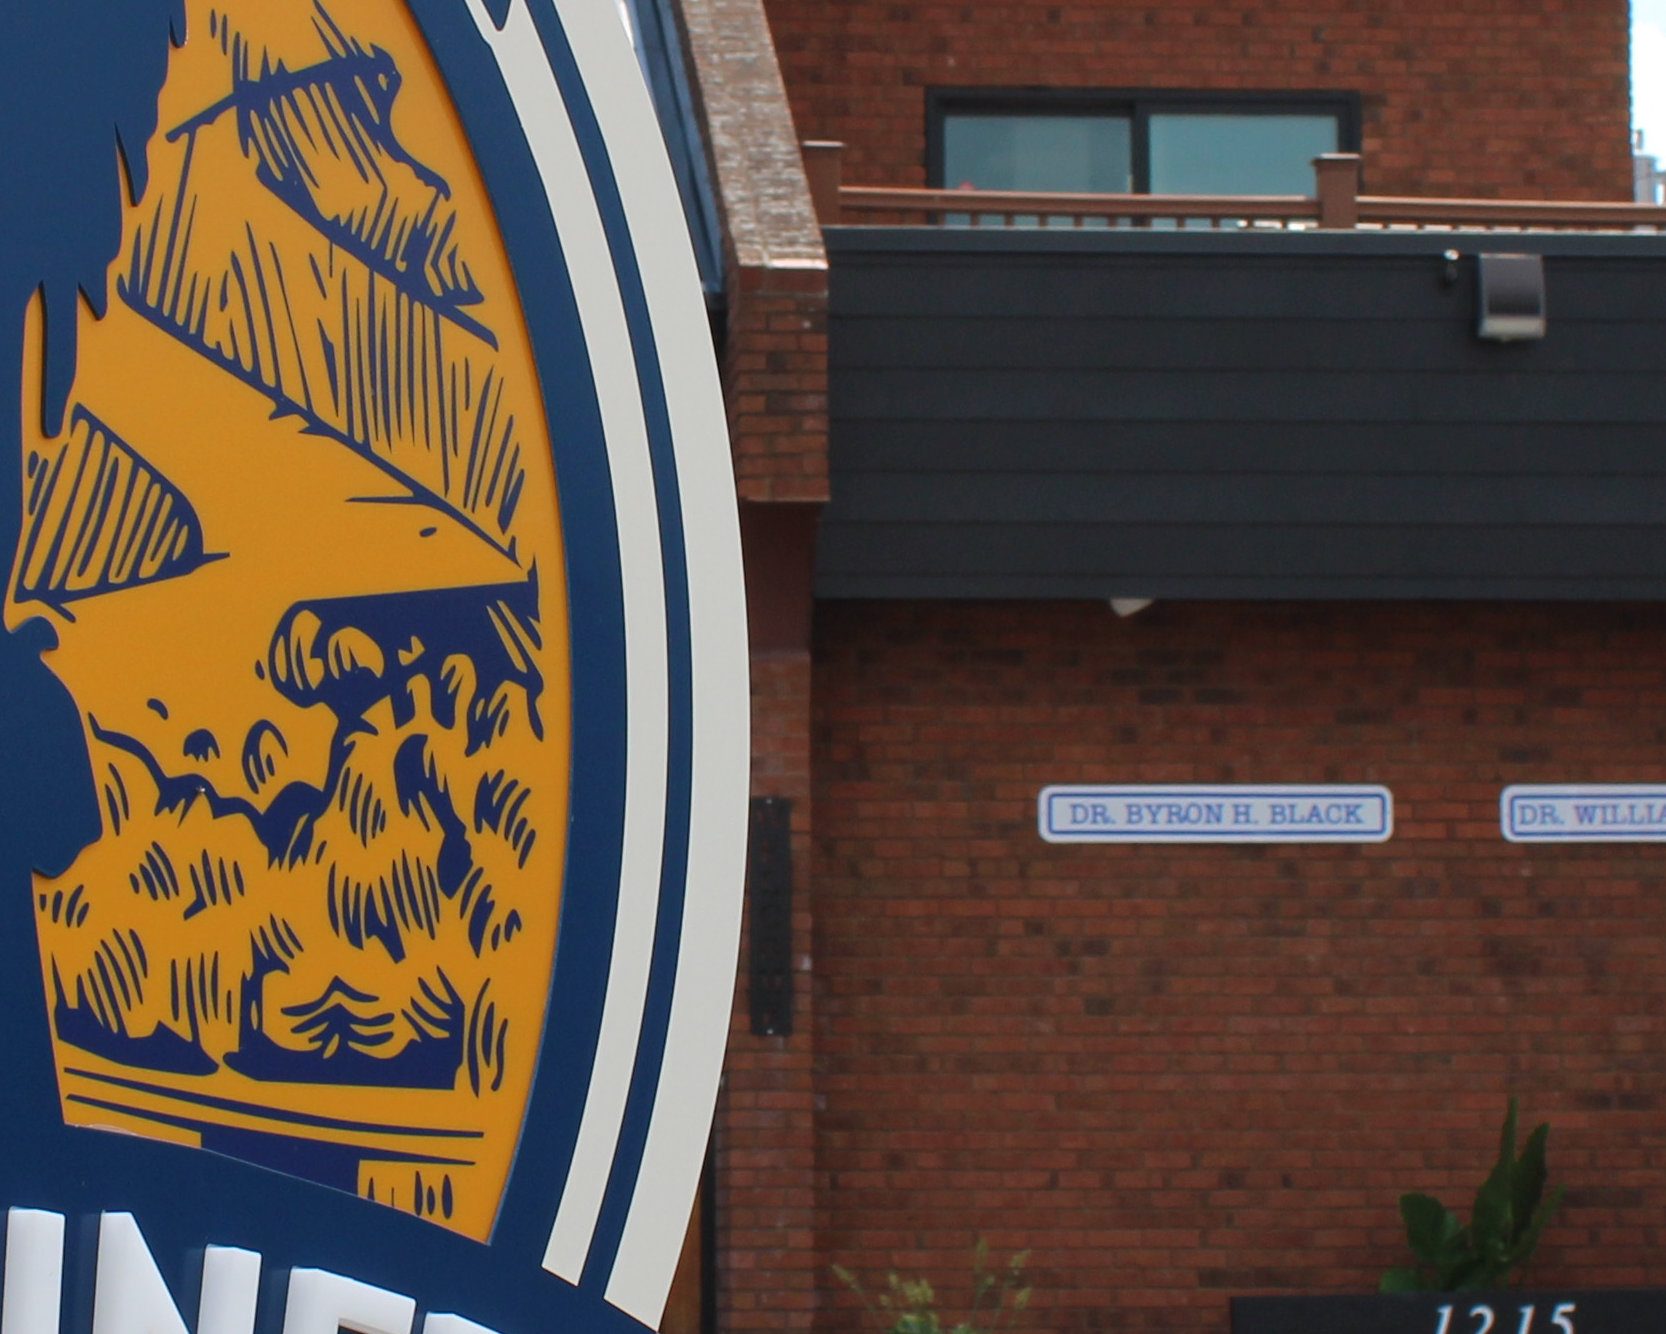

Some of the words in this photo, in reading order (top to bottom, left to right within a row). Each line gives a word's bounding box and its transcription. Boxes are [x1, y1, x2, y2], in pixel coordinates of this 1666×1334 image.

[1070, 802, 1116, 825] DR.
[1126, 802, 1225, 825] BYRON
[1232, 802, 1259, 825] H.
[1269, 802, 1364, 825] BLACK
[1518, 803, 1565, 826] DR.
